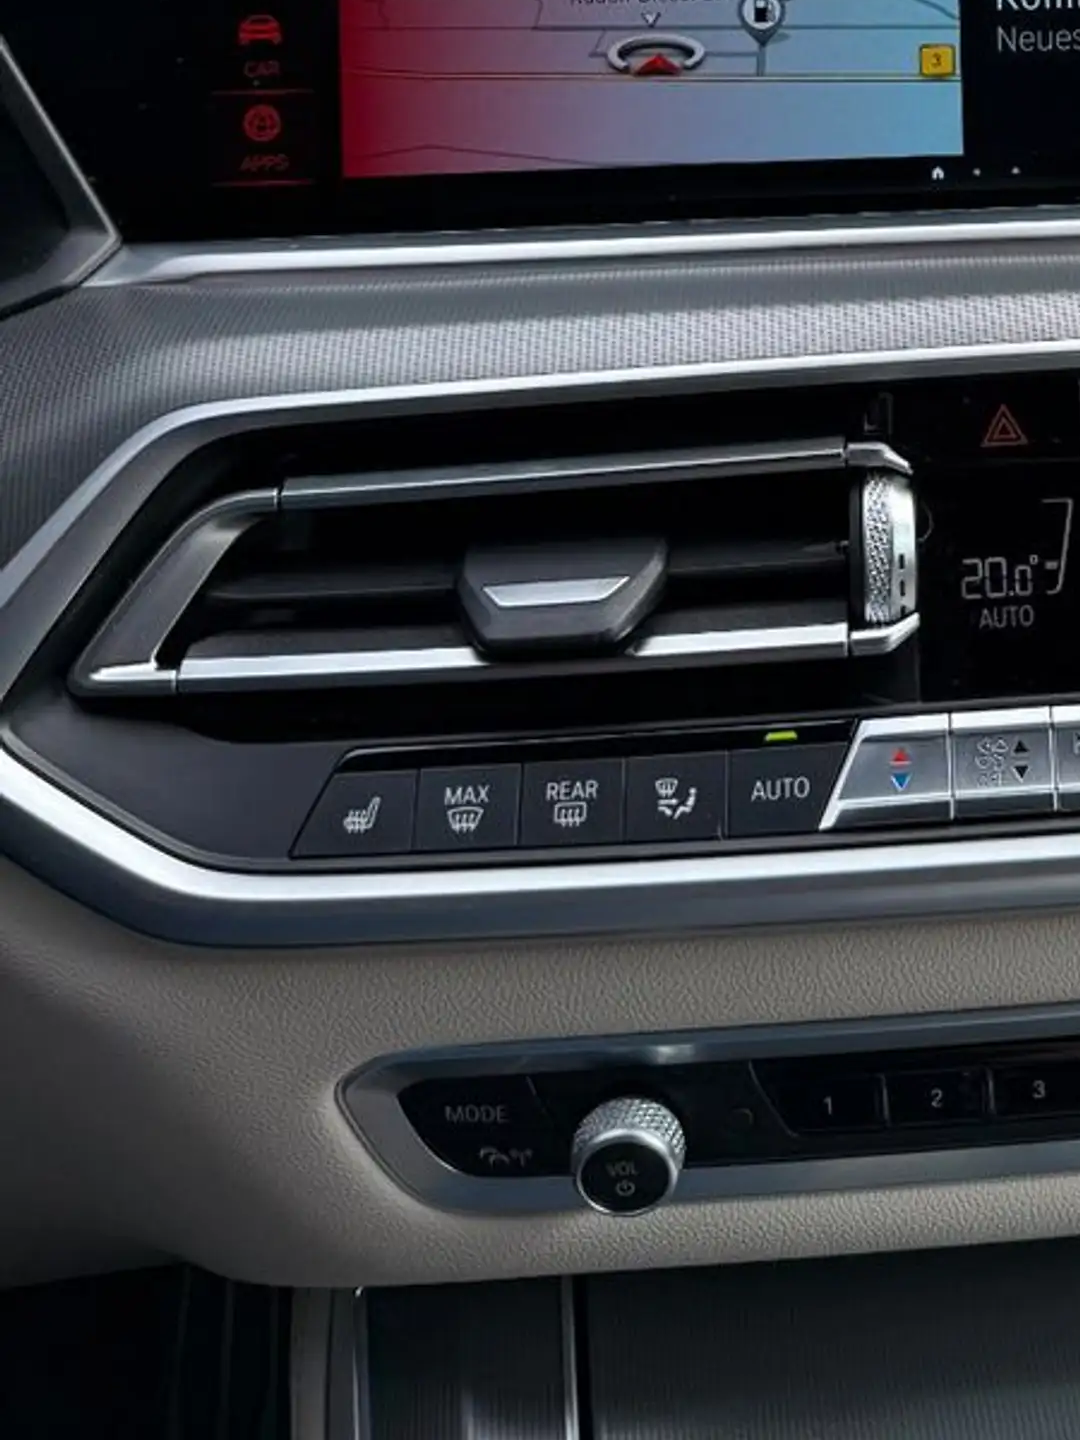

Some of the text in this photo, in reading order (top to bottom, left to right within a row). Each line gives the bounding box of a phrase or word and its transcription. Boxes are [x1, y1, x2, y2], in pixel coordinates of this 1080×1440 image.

[244, 60, 279, 77] CAR
[978, 605, 1035, 629] AUTO
[443, 785, 490, 805] MAX
[545, 780, 599, 801] REAR
[750, 777, 810, 801] AUTO
[930, 1088, 944, 1109] 2
[1032, 1080, 1047, 1100] 3
[443, 1104, 511, 1126] MODE
[822, 1096, 834, 1116] 1
[605, 1161, 640, 1178] VOL
